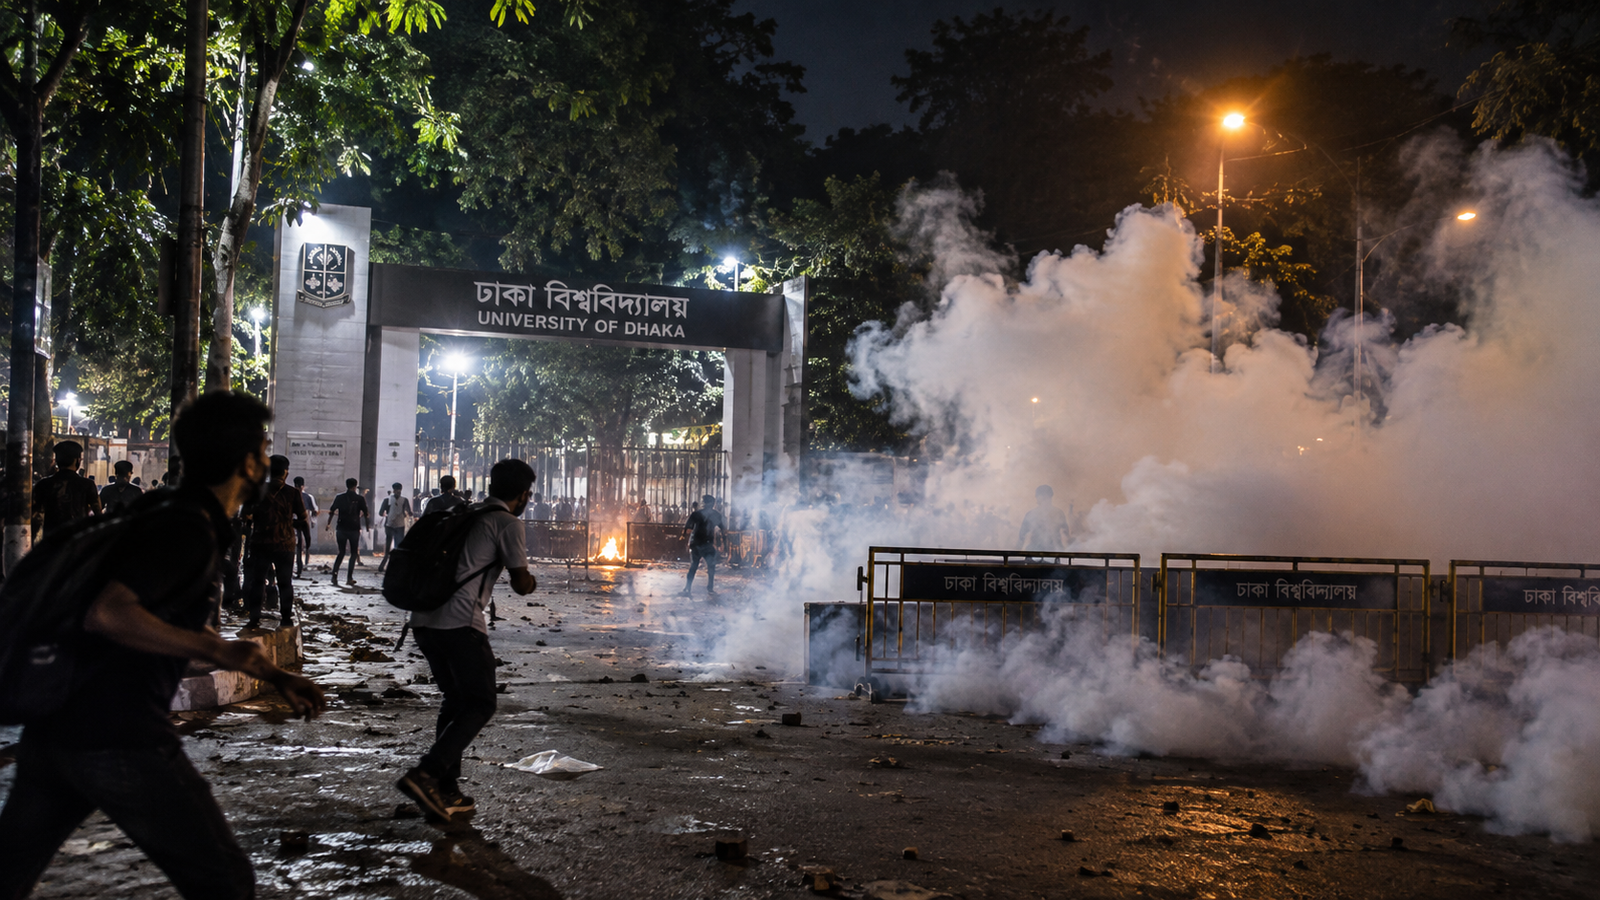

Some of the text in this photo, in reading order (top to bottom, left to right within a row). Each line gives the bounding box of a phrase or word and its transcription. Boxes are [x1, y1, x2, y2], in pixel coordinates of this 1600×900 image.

[474, 279, 690, 319] ঢাকা বিশ্ববিদ্যালয়
[478, 310, 686, 338] UNIVERSITY OF DHAKA
[944, 575, 977, 592] ঢাকা
[1236, 578, 1357, 601] ঢাকা বিশ্ববিদ্যালয়
[1523, 588, 1557, 605] ঢাকা
